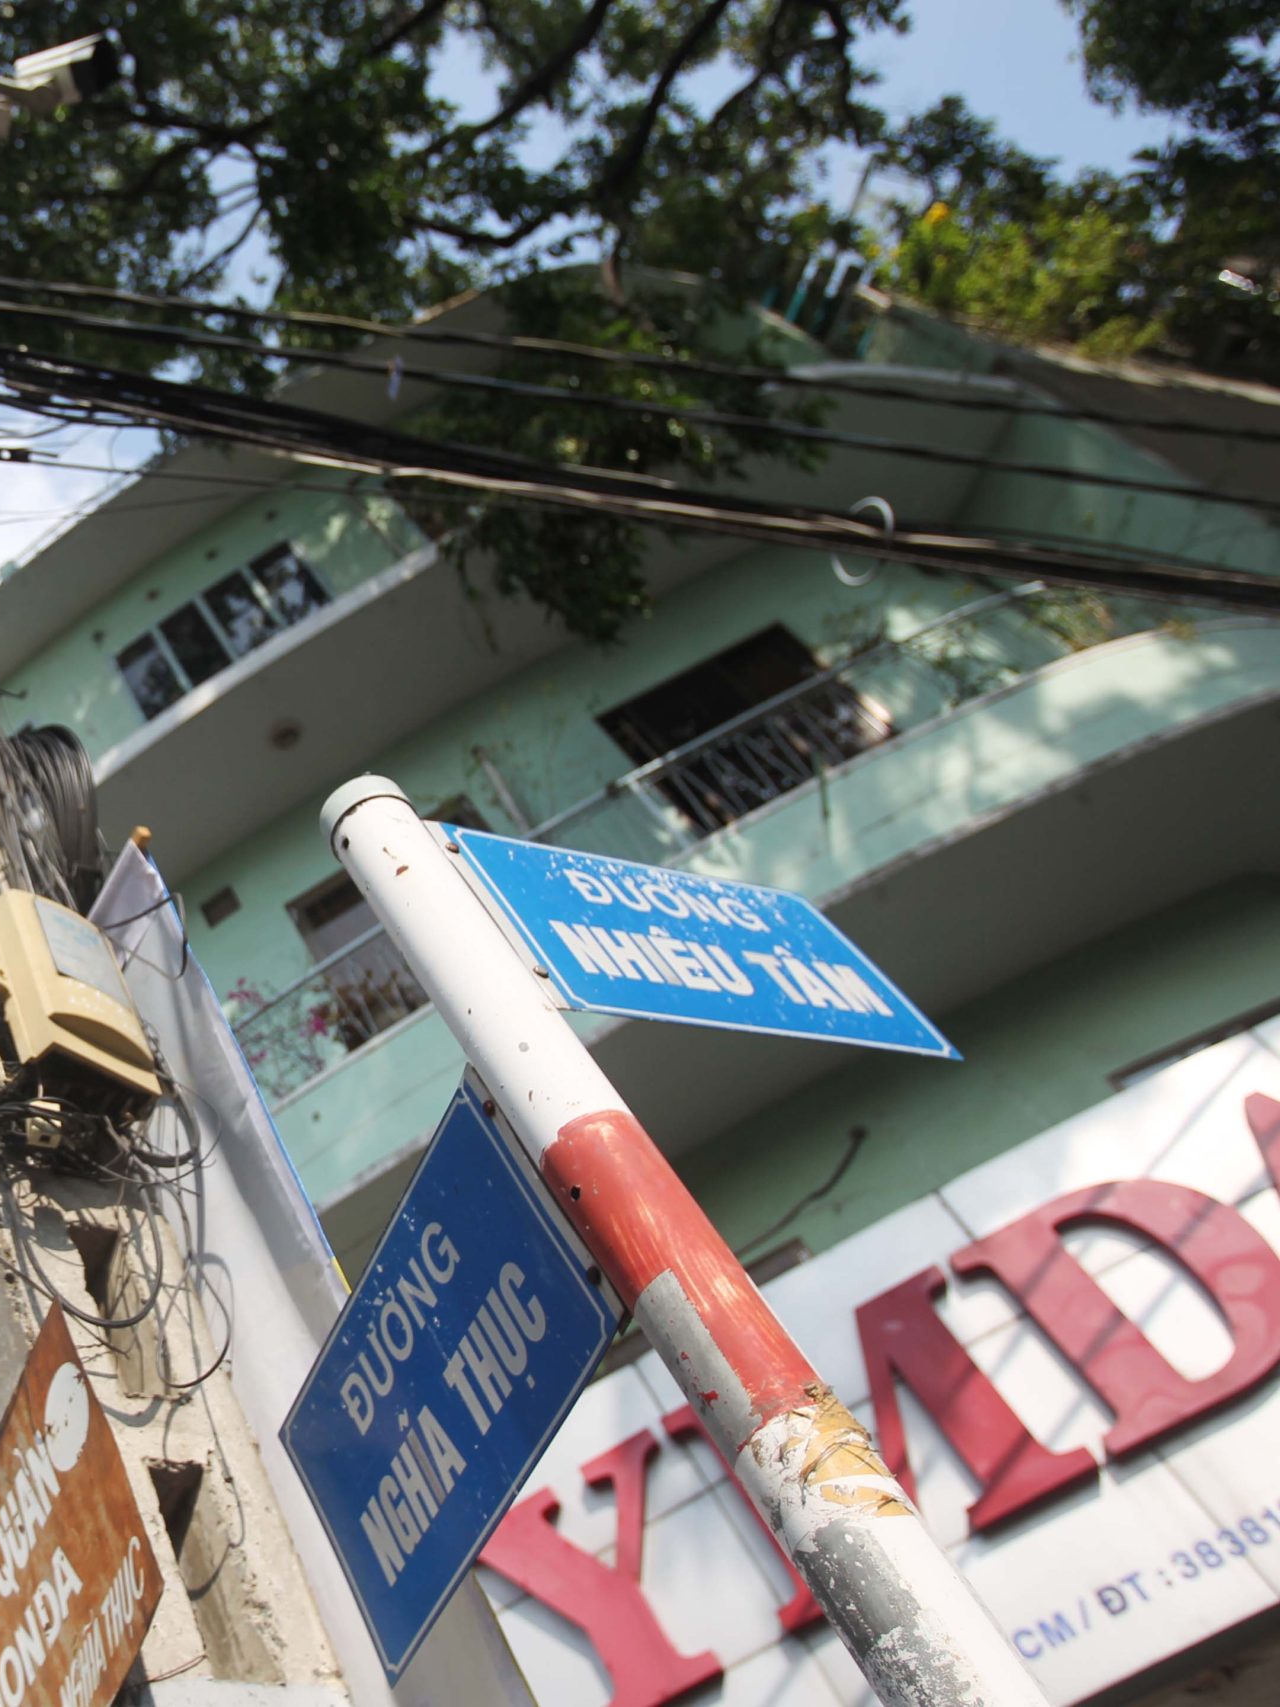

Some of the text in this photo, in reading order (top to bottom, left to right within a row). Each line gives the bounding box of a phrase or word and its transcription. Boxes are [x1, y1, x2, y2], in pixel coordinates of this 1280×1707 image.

[564, 867, 771, 933] ĐƯỜNG
[742, 944, 895, 1018] TÂM
[338, 1221, 462, 1437] ĐƯỜNG
[359, 1261, 547, 1588] NGHĨA THỤC
